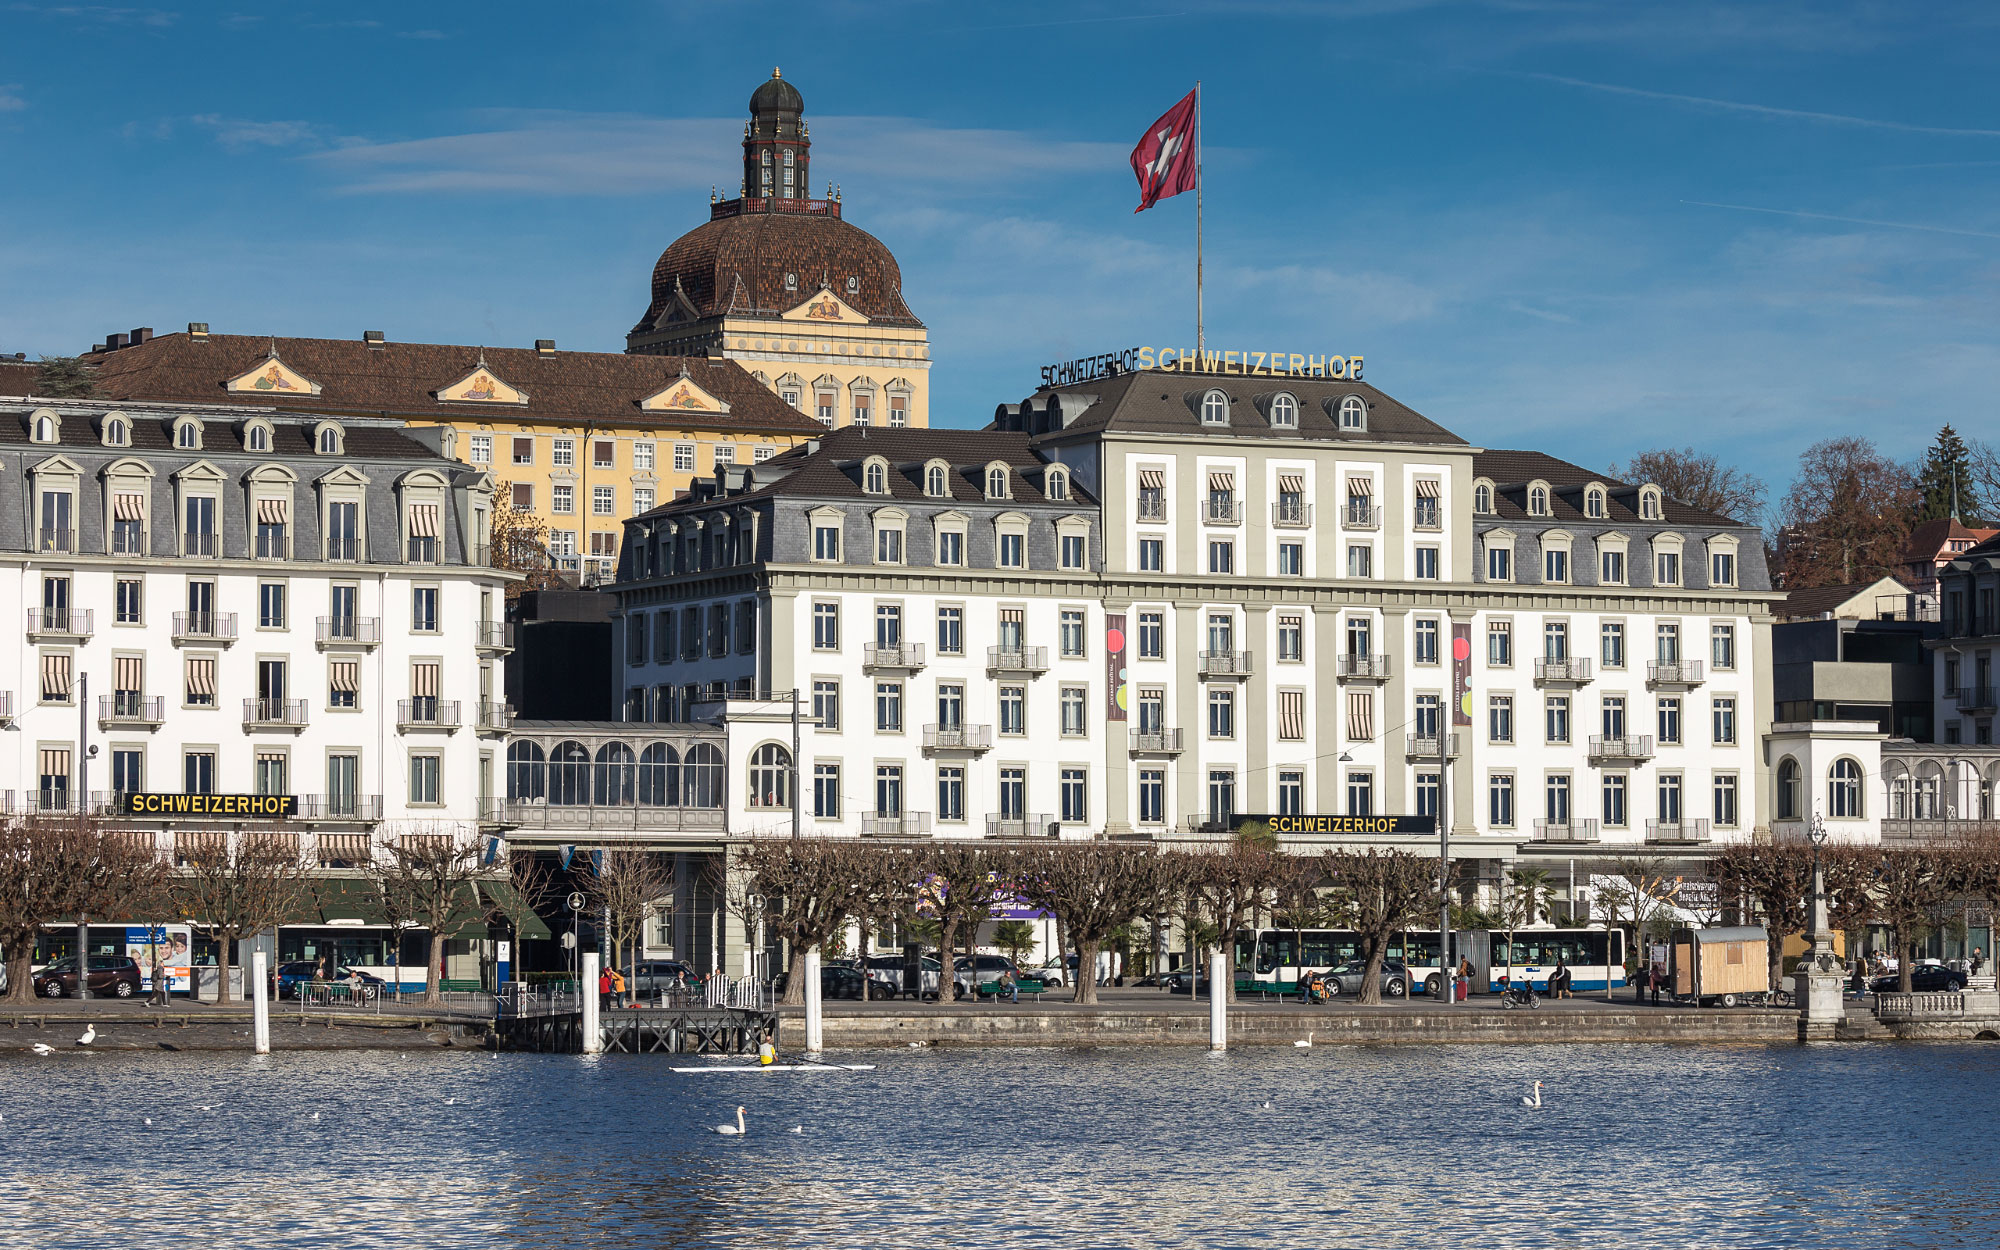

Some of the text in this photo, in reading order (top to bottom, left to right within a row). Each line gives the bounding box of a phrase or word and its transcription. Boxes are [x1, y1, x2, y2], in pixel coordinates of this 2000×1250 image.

[1041, 347, 1139, 387] SCHWEIZERHOF
[1138, 346, 1364, 379] SCHWEIZERHOF
[132, 794, 291, 814] SCHWEIZERHOF
[1269, 817, 1398, 833] SCHWEIZERHOF
